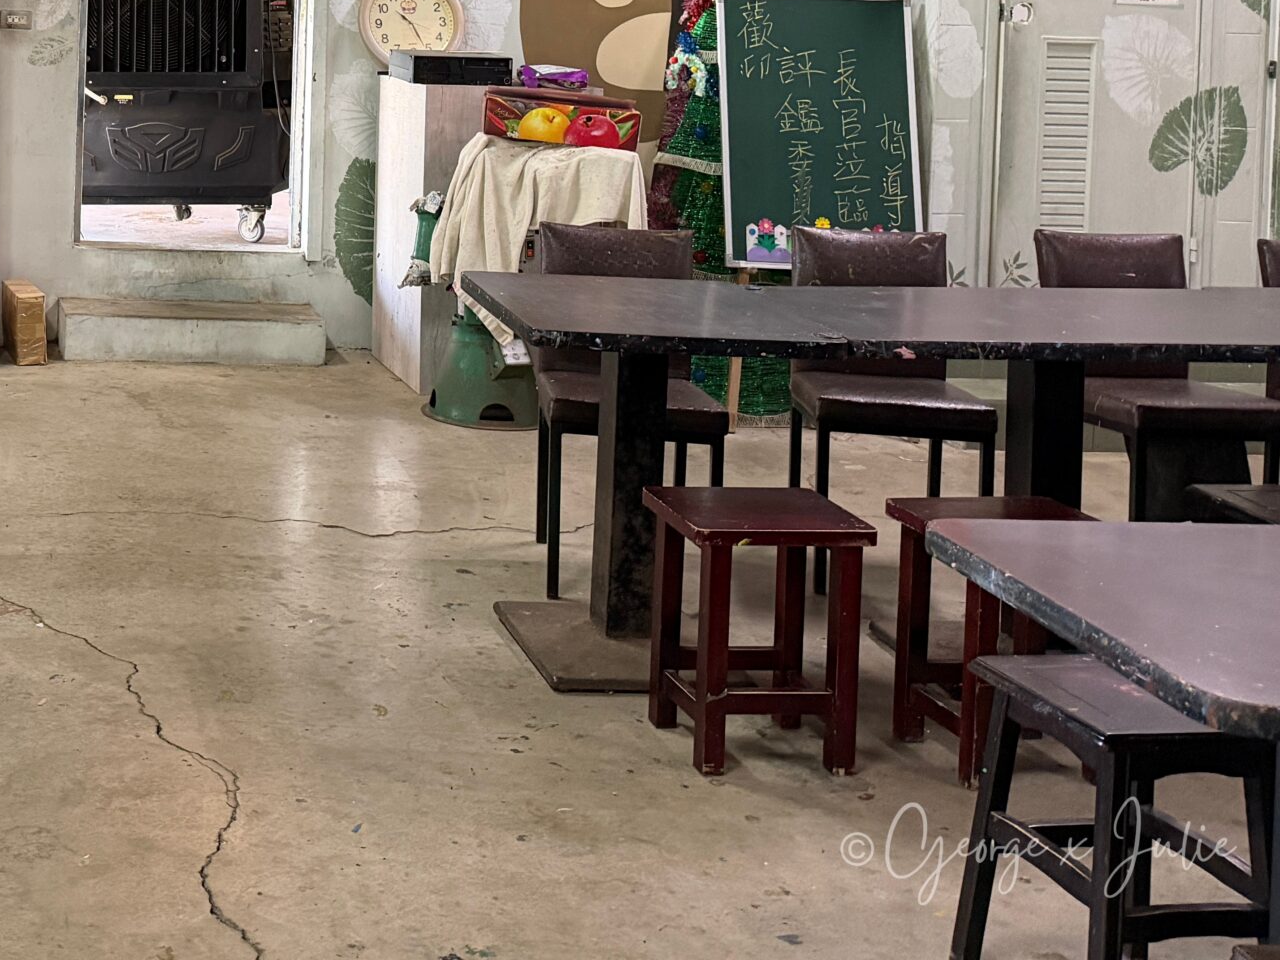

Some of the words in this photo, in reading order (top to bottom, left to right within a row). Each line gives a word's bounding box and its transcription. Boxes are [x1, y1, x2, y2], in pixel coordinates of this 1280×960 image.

[378, 3, 389, 14] 10
[432, 2, 441, 13] 2
[375, 18, 383, 29] 9
[438, 16, 447, 27] 3
[381, 33, 389, 44] 8
[435, 32, 443, 42] 4
[737, 0, 779, 80] 歡迎
[875, 113, 909, 228] 指導
